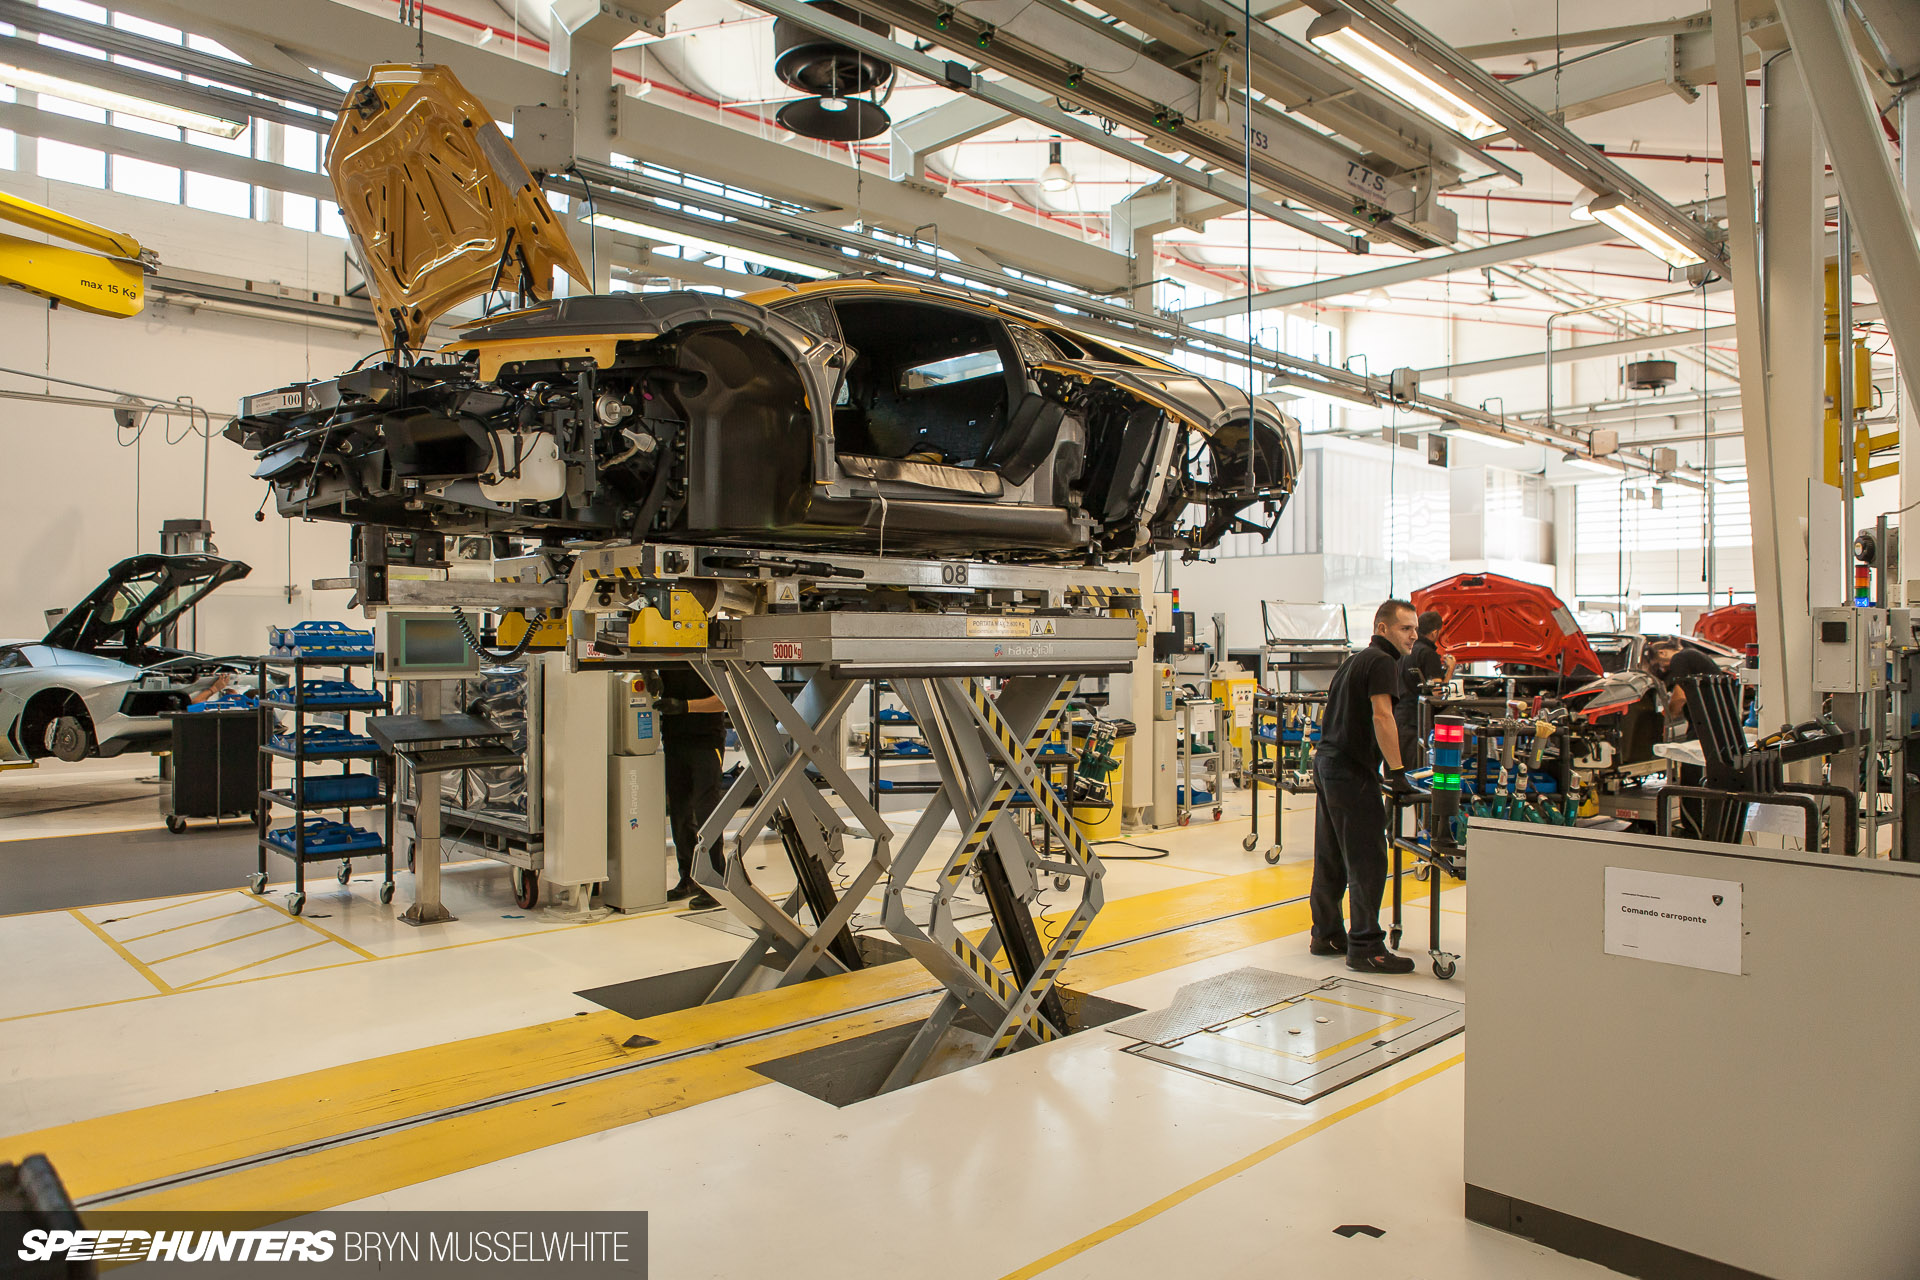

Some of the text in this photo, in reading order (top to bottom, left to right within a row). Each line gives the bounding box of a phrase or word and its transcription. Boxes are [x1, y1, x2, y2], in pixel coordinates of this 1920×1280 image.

[1347, 161, 1386, 194] T.T.S.
[80, 279, 136, 300] max 15 Kg
[282, 394, 301, 406] 100
[942, 564, 967, 585] 08
[773, 643, 801, 659] 3000 kg
[630, 769, 639, 815] Ravaglioli
[1621, 905, 1707, 924] Comando carroponte
